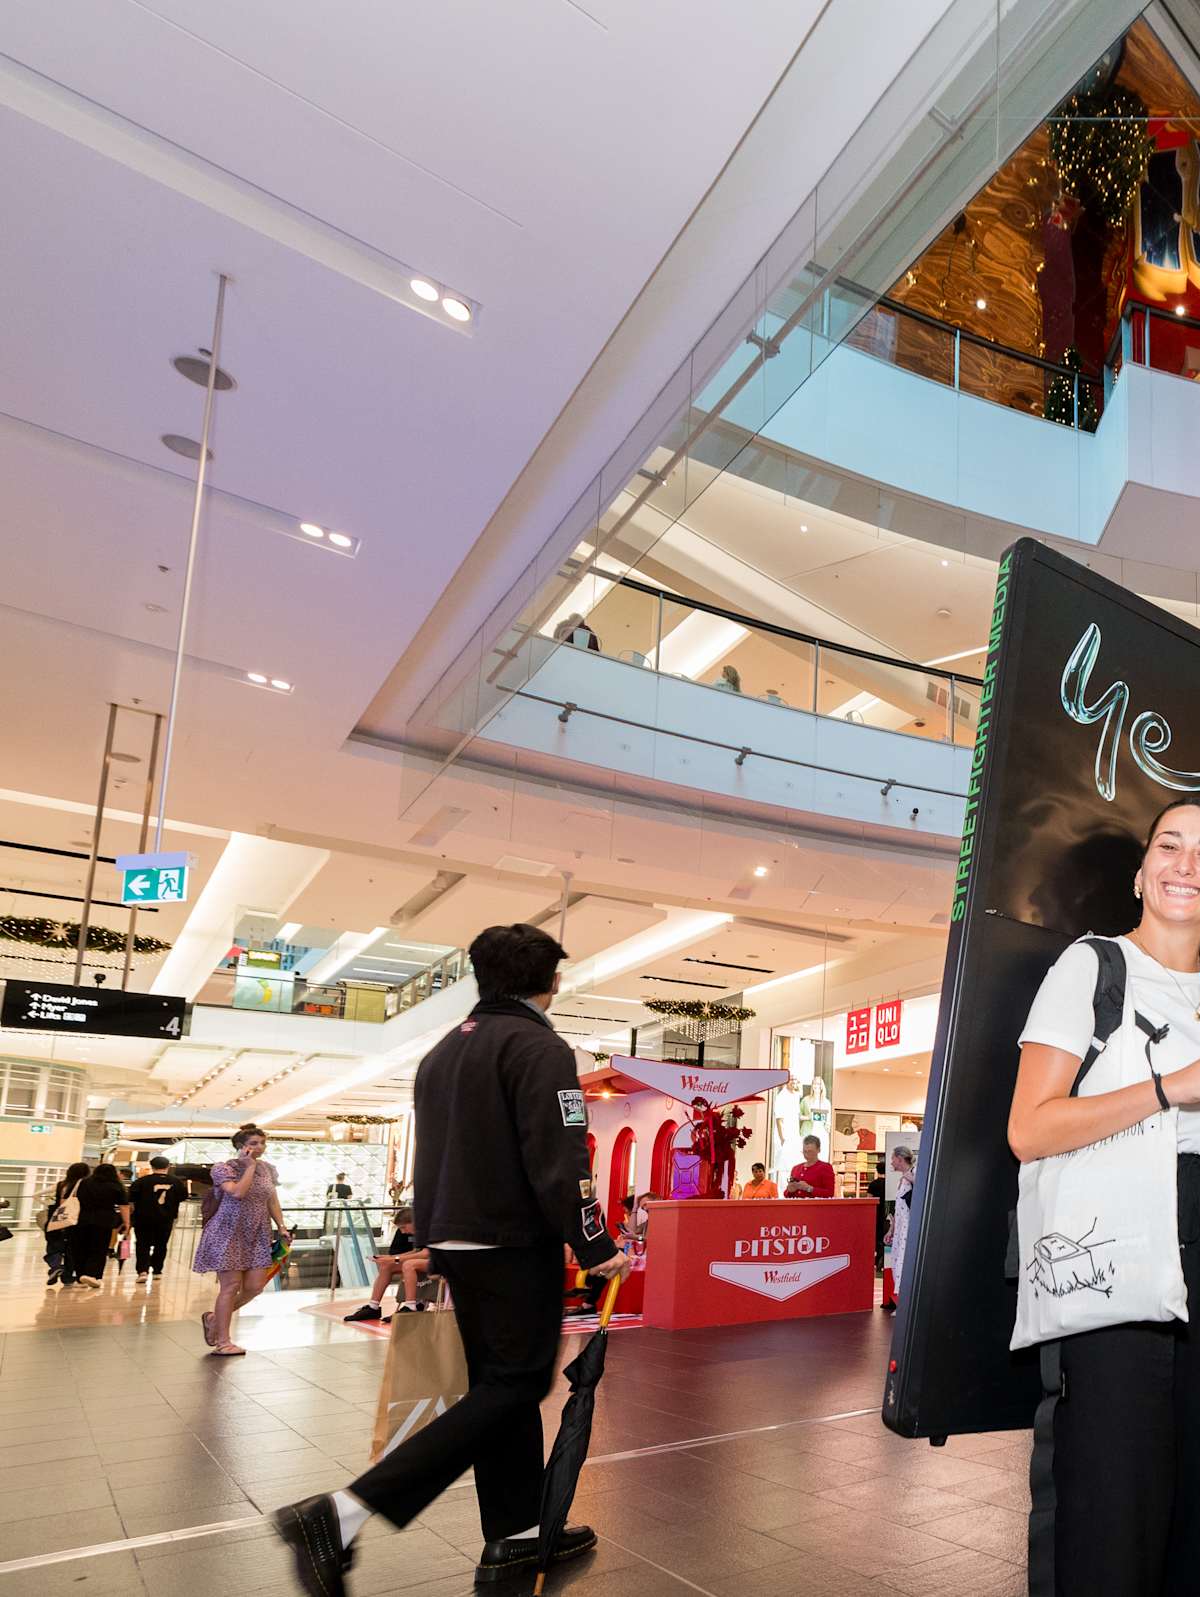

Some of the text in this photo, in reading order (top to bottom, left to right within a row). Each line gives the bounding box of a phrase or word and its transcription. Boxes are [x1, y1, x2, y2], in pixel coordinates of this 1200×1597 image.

[951, 551, 1013, 923] STREETFIGHTER MEDIA
[680, 1073, 730, 1094] Westfield
[760, 1225, 808, 1238] BONDI
[734, 1236, 831, 1258] PITSTOP
[763, 1270, 802, 1285] Westfield
